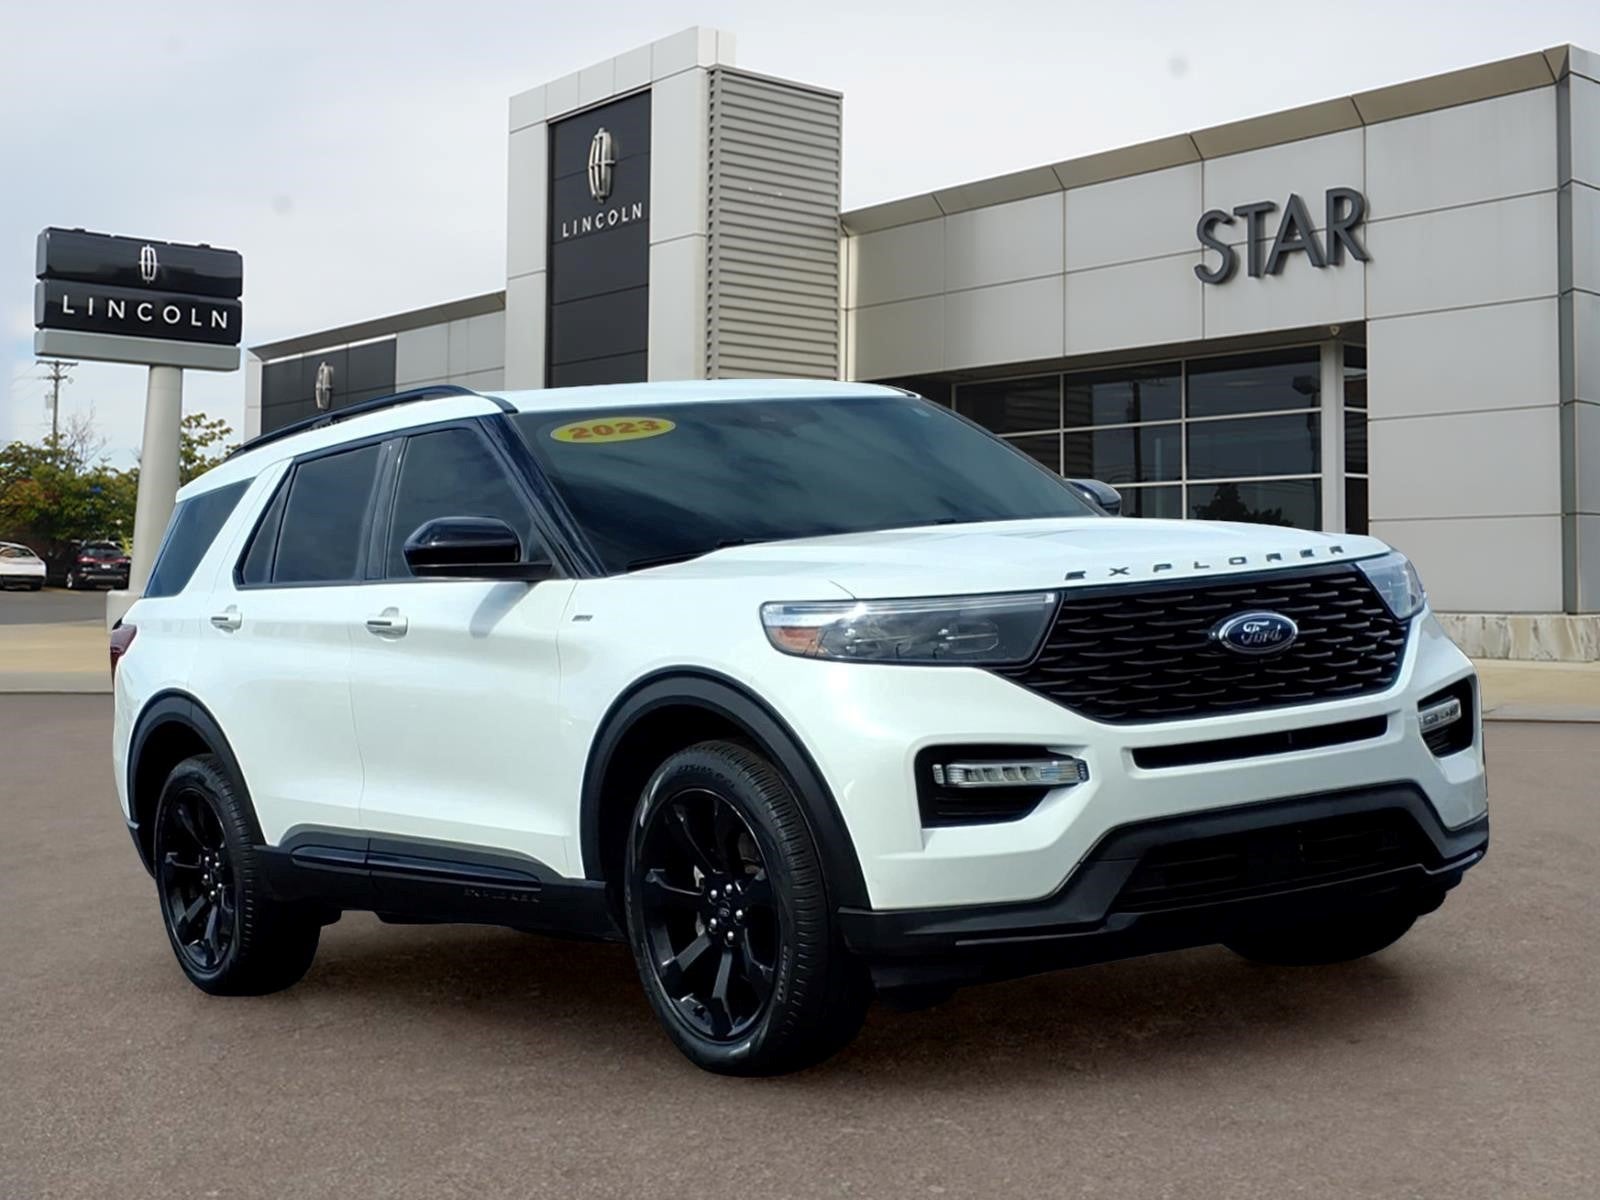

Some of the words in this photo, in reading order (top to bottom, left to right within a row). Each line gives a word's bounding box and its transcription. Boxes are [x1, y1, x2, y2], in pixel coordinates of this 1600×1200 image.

[562, 202, 642, 237] LINCOLN
[1194, 187, 1370, 284] STAR
[63, 295, 228, 329] LINCOLN
[568, 420, 661, 440] 2023
[1064, 545, 1344, 580] EXPLORER
[1240, 619, 1282, 644] Ford
